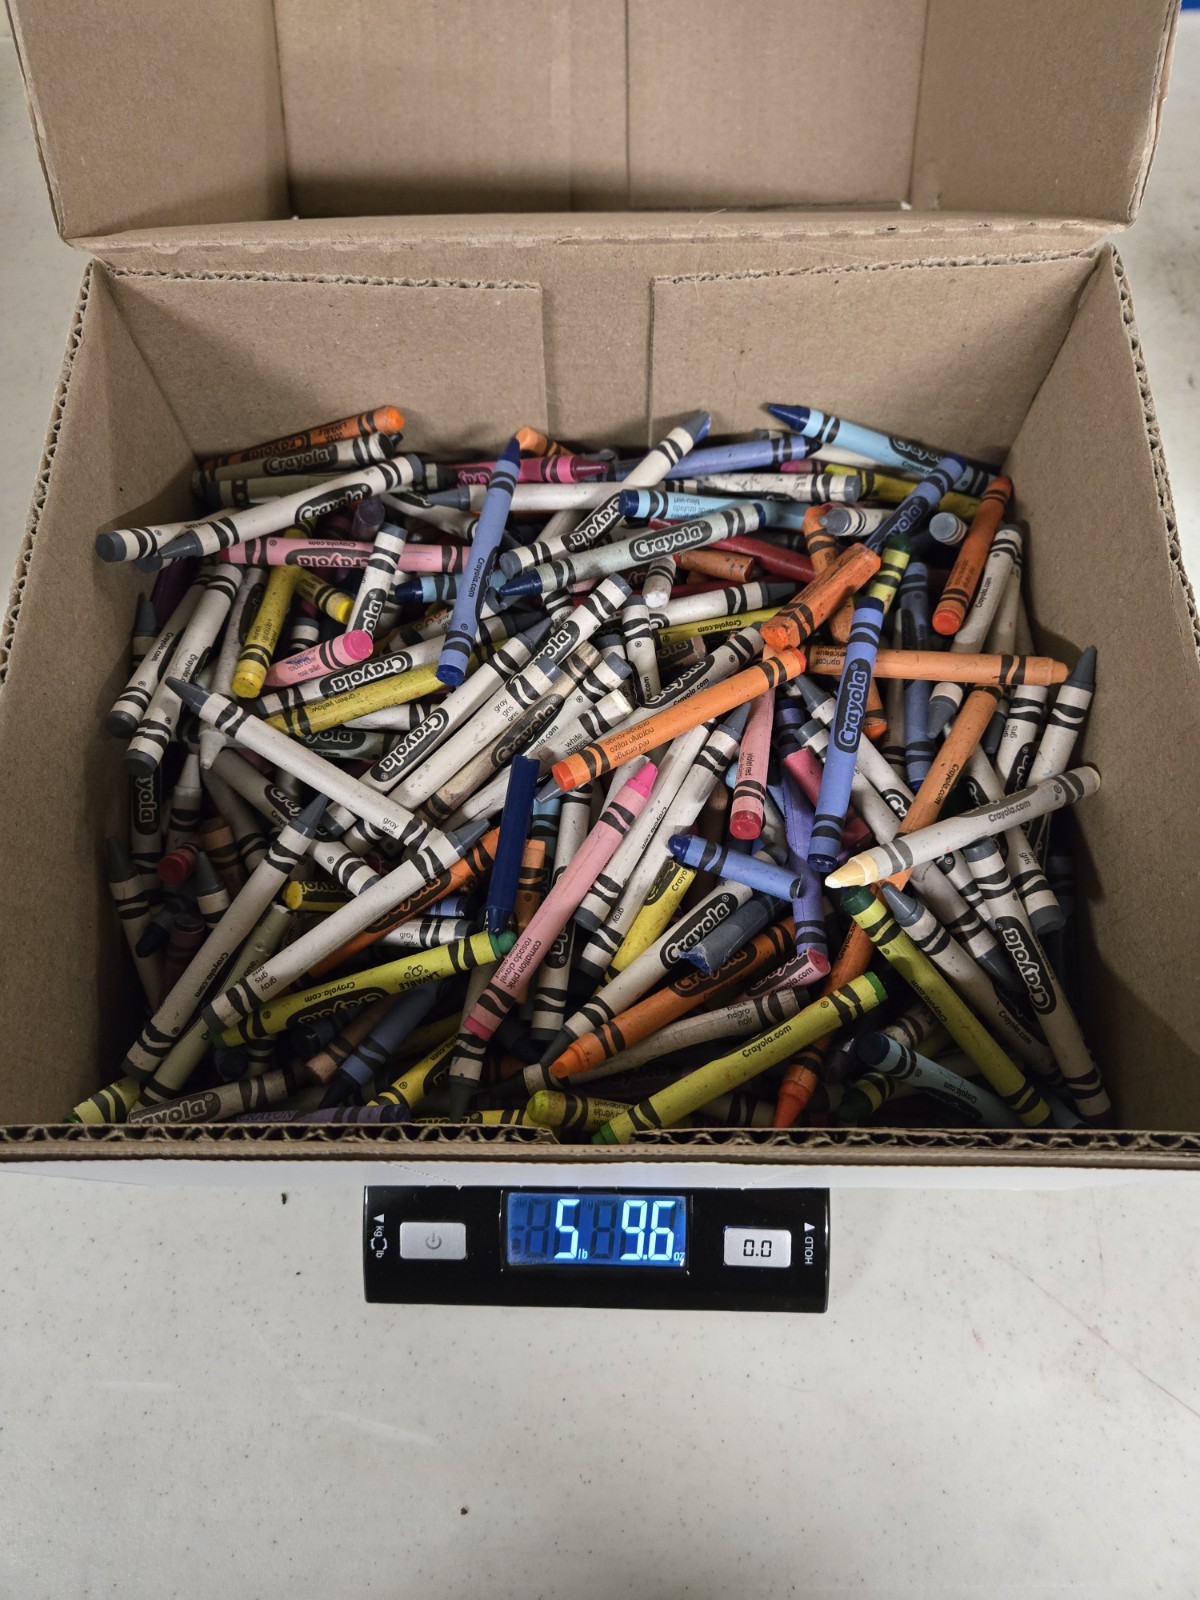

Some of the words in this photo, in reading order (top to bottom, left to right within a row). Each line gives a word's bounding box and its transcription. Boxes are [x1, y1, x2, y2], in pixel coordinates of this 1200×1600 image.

[267, 449, 330, 473] Crayola
[308, 540, 356, 548] Crayola.com
[634, 526, 702, 558] Crayola
[467, 557, 486, 598] Crayola.com
[975, 577, 992, 608] Crayola.com
[697, 619, 742, 633] Crayola.com
[151, 632, 175, 662] Crayola.com
[332, 655, 407, 693] Crayola
[494, 698, 508, 713] gray
[502, 705, 514, 717] gris
[838, 670, 868, 747] Crayola
[380, 711, 445, 772] Crayola
[498, 703, 556, 762] Crayola
[564, 732, 583, 749] white
[629, 727, 655, 745] naranja
[610, 740, 629, 753] rojizo
[613, 745, 638, 762] orange
[637, 740, 651, 752] red
[934, 763, 959, 806] Crayola.com
[382, 816, 399, 830] gray
[988, 800, 1032, 823] Crayola.com
[612, 907, 625, 924] gray
[399, 931, 415, 942] gray
[666, 902, 730, 963] Crayola
[510, 936, 532, 962] rosado
[516, 940, 542, 975] carnation
[195, 952, 229, 998] Crayola.com
[399, 970, 441, 989] LAVABLE
[499, 961, 517, 985] clavel
[506, 968, 523, 990] pink
[1002, 927, 1051, 1010] Crayola
[260, 976, 277, 991] gray
[304, 981, 356, 1003] Crayola.com
[911, 980, 947, 1023] Crayola.com
[737, 1016, 753, 1027] noir
[999, 1009, 1033, 1045] Crayola.com
[742, 1024, 793, 1058] Crayola.com
[943, 1081, 977, 1104] Crayola.com
[374, 1226, 384, 1239] kg
[554, 1198, 580, 1260] 5
[620, 1199, 676, 1261] 9.6
[743, 1239, 772, 1258] 0.0
[803, 1235, 814, 1265] HOLD
